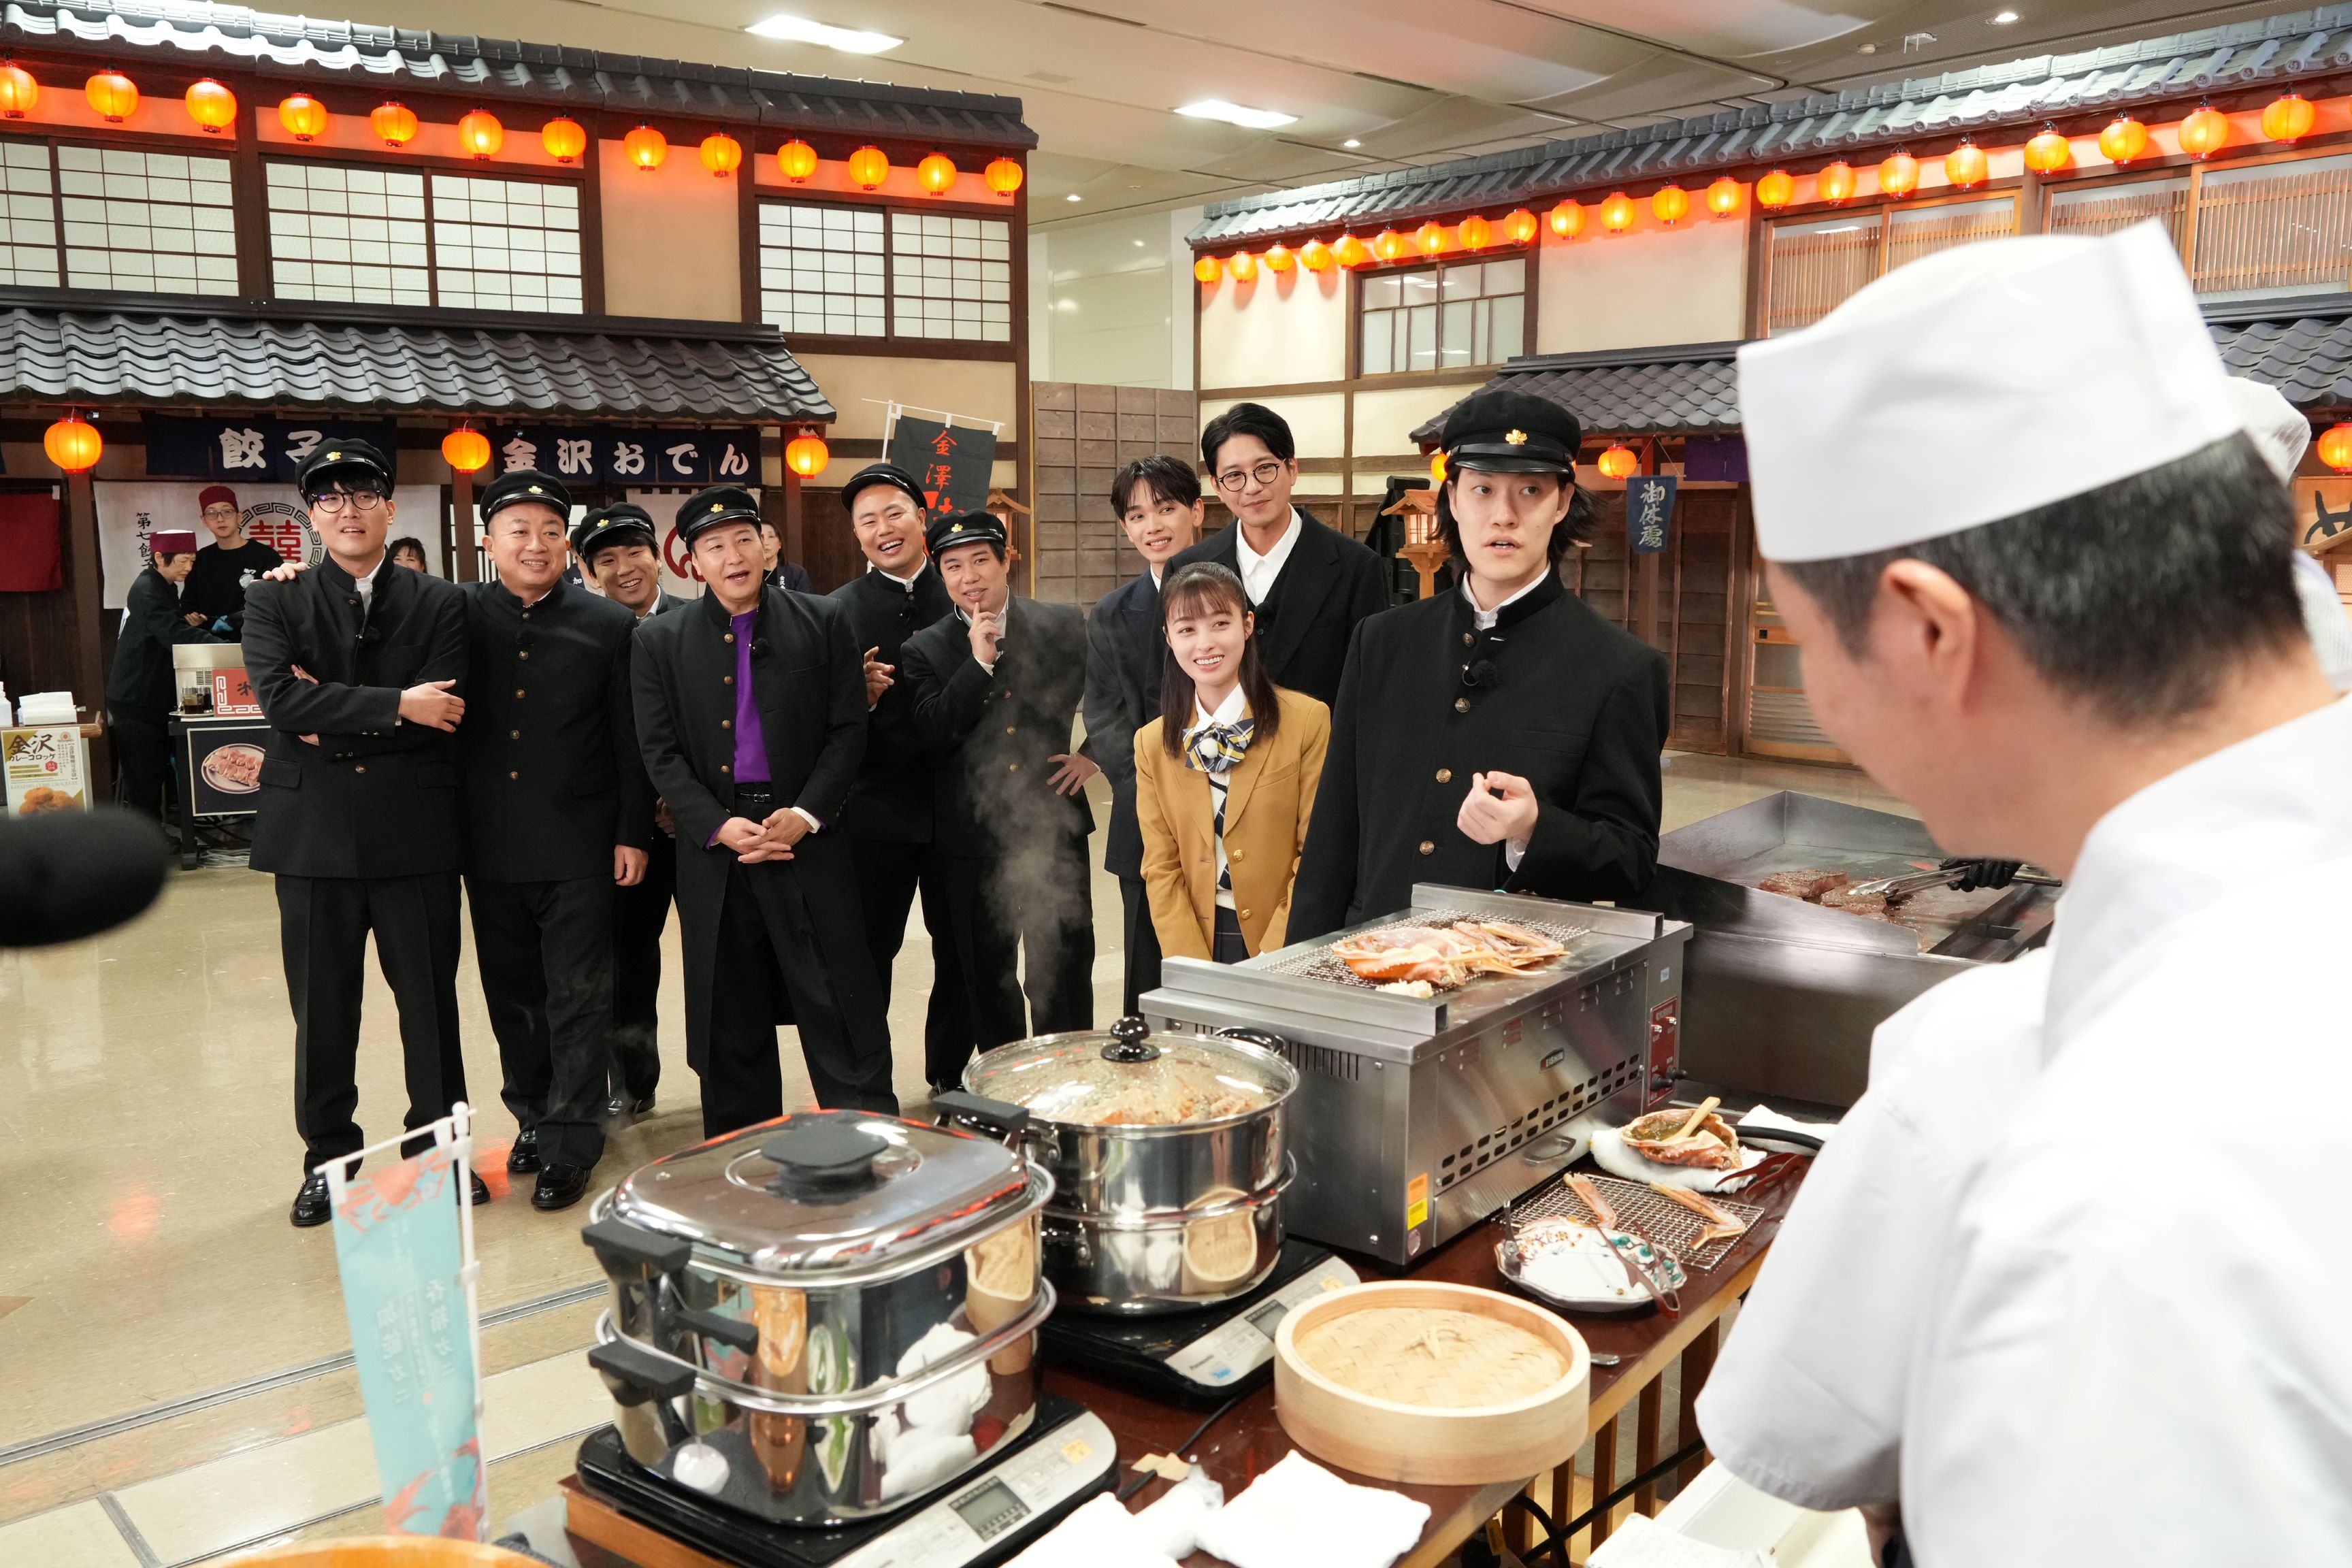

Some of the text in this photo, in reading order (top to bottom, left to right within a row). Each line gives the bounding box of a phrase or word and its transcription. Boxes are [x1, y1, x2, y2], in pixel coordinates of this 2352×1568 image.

[218, 427, 323, 470] 餃子
[502, 438, 749, 476] 金沢おでん
[7, 734, 56, 755] 金沢
[8, 753, 56, 762] カレーコロッケ
